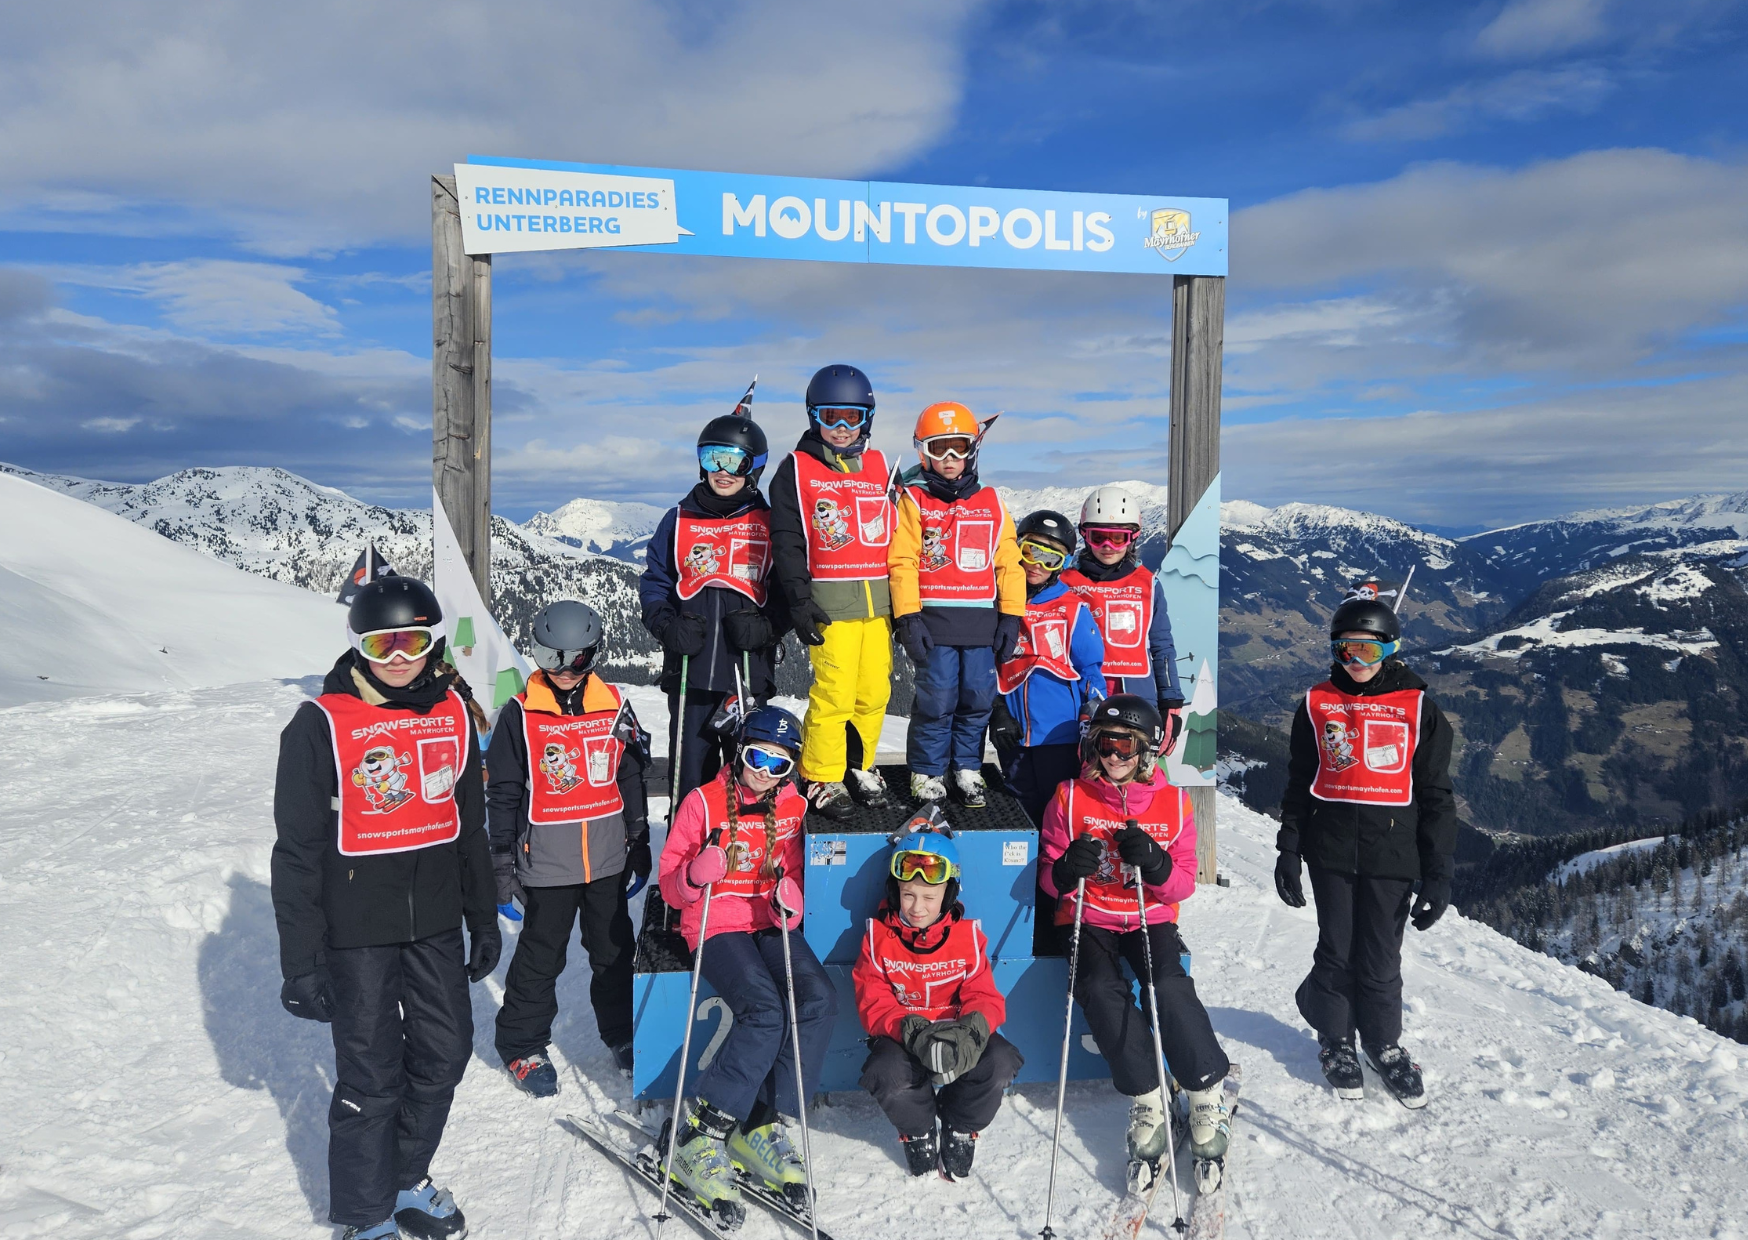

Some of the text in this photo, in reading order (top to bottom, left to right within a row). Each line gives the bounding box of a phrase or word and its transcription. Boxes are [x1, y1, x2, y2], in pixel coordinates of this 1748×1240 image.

[474, 186, 660, 210] RENNPARADIES
[1137, 206, 1148, 220] by
[476, 213, 622, 234] UNTERBERG
[722, 192, 1115, 253] MOUNTOPOLIS
[1144, 231, 1201, 249] Mayrhofner
[810, 479, 883, 491] SNOWSPORTS
[690, 522, 767, 533] SNOWSPORTS
[1320, 703, 1406, 716] SNOWSPORTS
[1360, 712, 1406, 720] MAYRHOFEN
[351, 716, 455, 740] SNOWSPORTS
[409, 726, 455, 736] MAYRHOFEN
[538, 717, 614, 733] SNOWSPORTS
[1324, 783, 1403, 794] snowsportsmayrhofen.com
[542, 797, 619, 814] snowsportsmayrhofen.com
[357, 820, 453, 840] snowsportsmayrhofen.com
[883, 957, 966, 973] SNOWSPORTS
[696, 996, 734, 1071] 2
